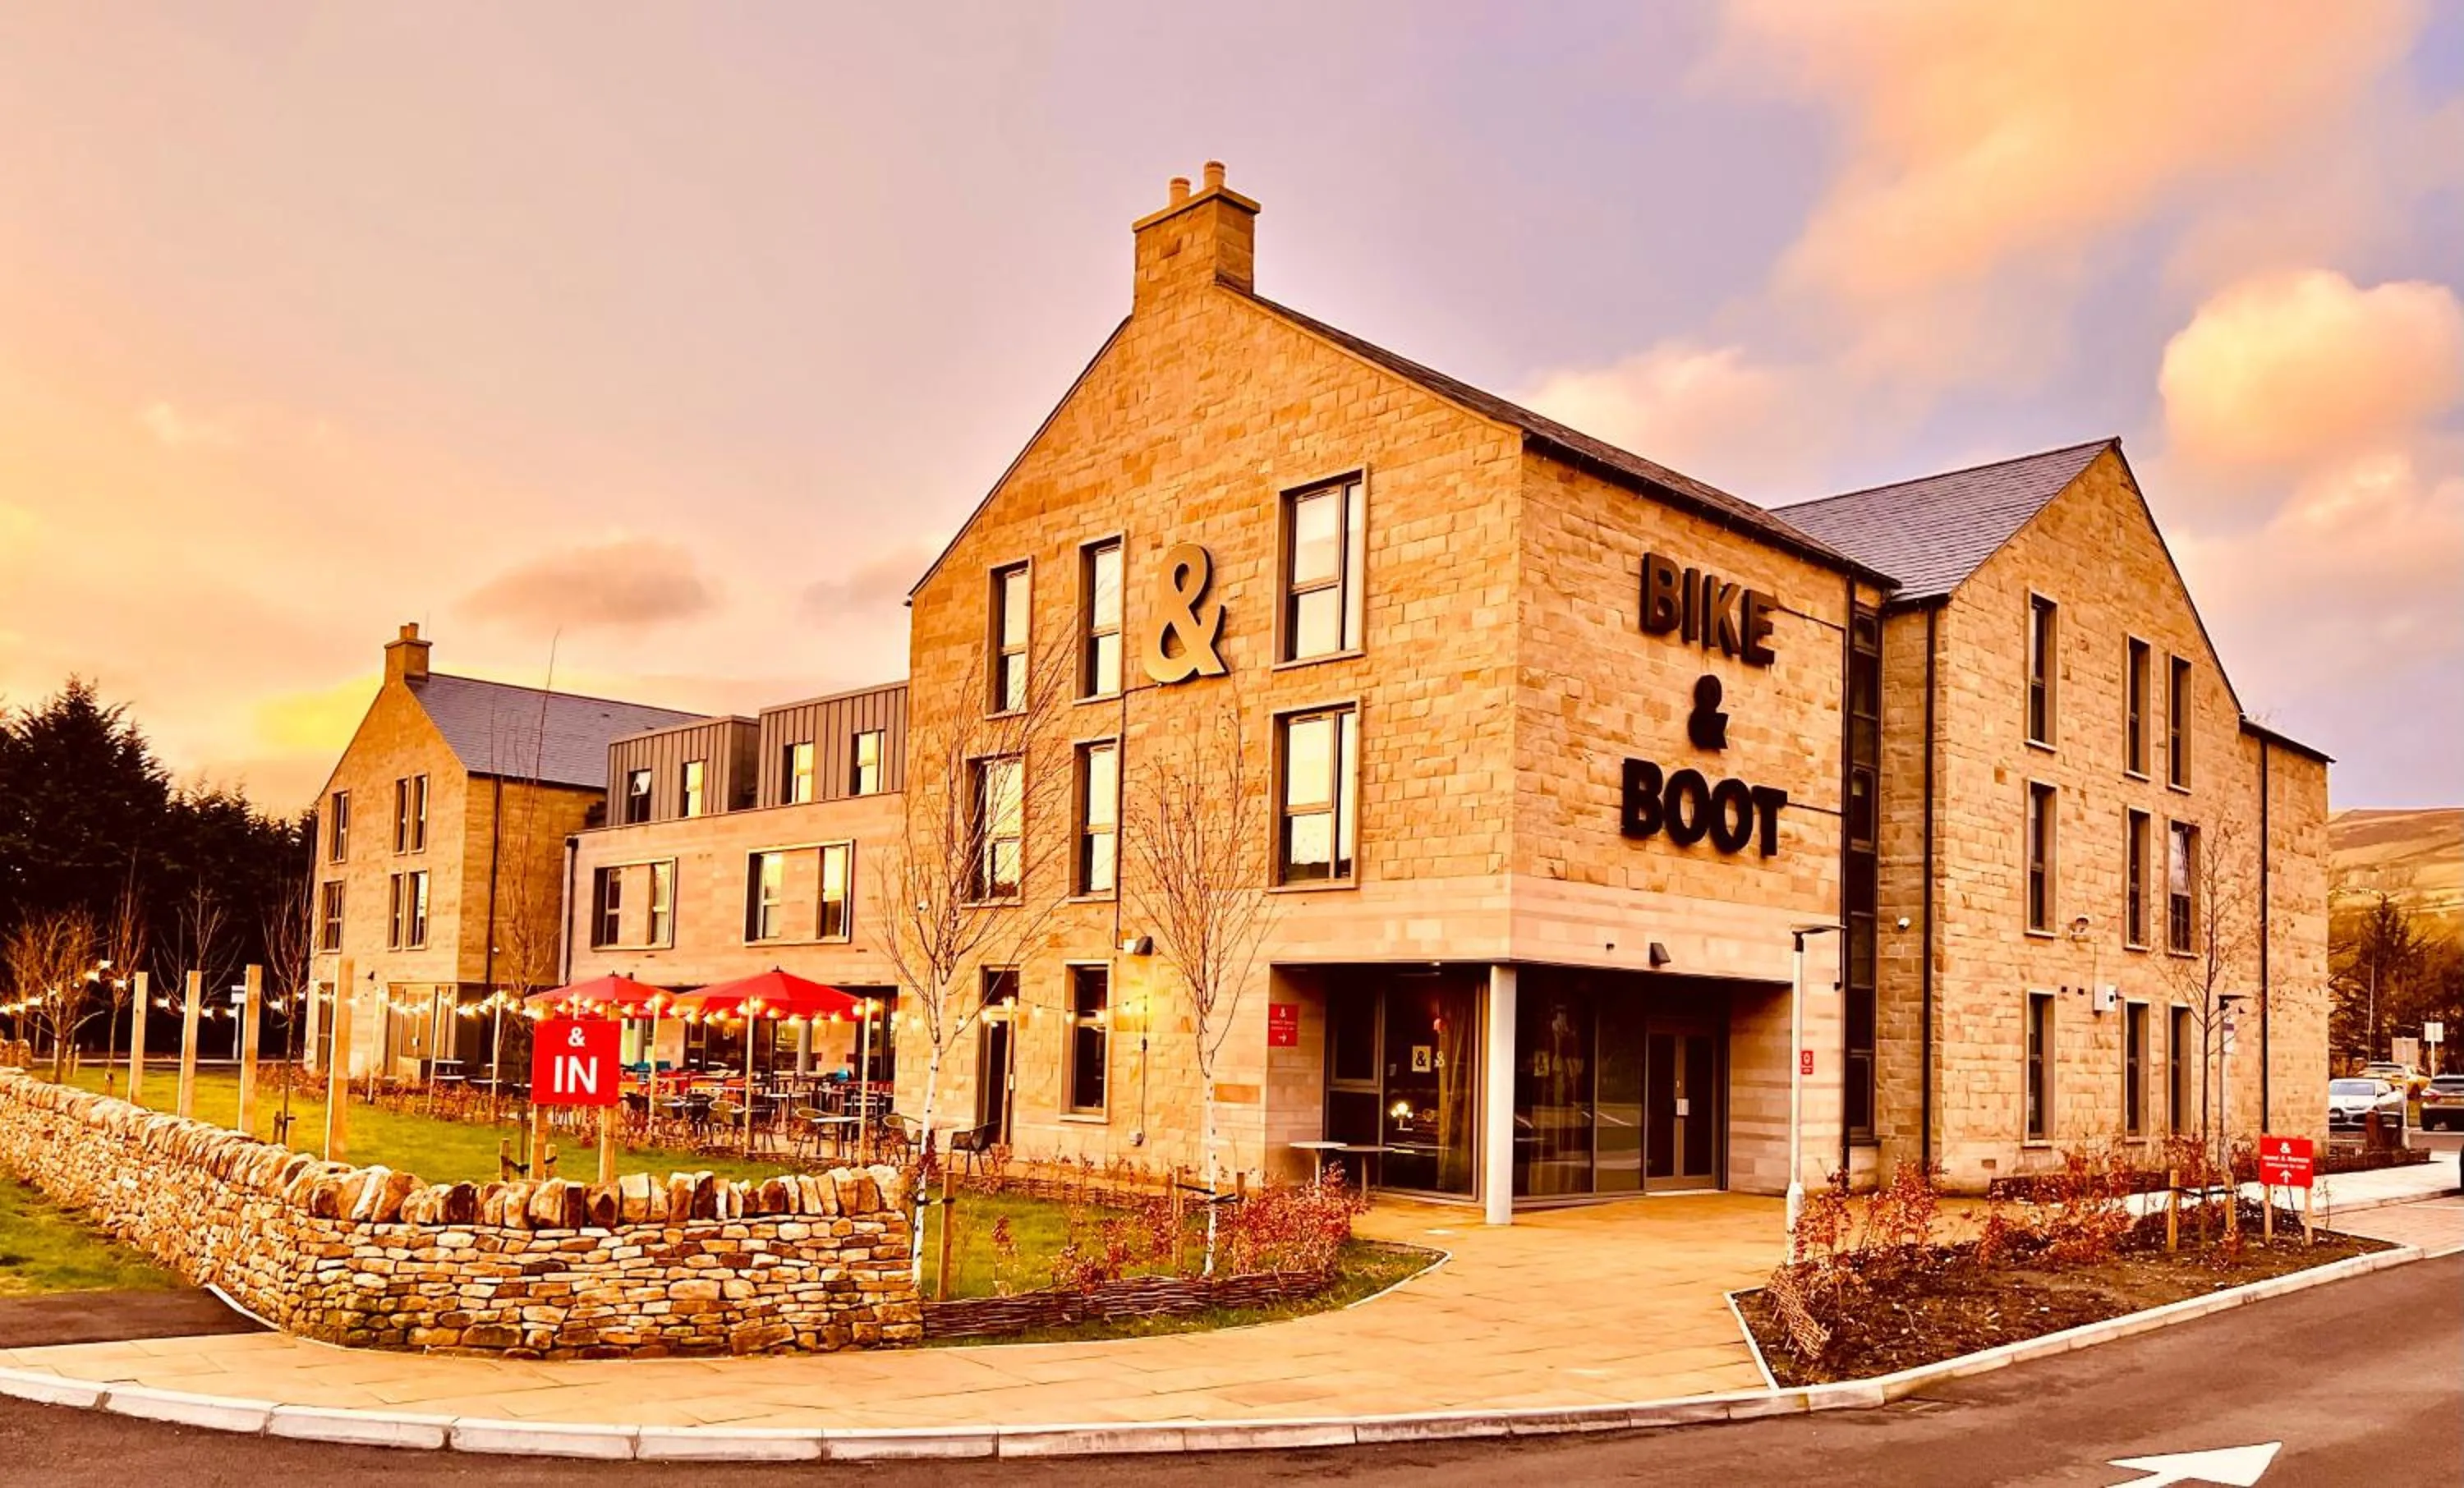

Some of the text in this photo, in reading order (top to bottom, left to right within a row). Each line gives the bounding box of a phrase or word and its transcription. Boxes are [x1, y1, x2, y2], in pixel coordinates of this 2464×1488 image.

[1142, 542, 1230, 683] &
[1640, 552, 1777, 666] BIKE
[1688, 674, 1729, 751] &
[1621, 758, 1788, 858] BOOT
[554, 1055, 598, 1094] IN
[568, 1026, 585, 1047] &
